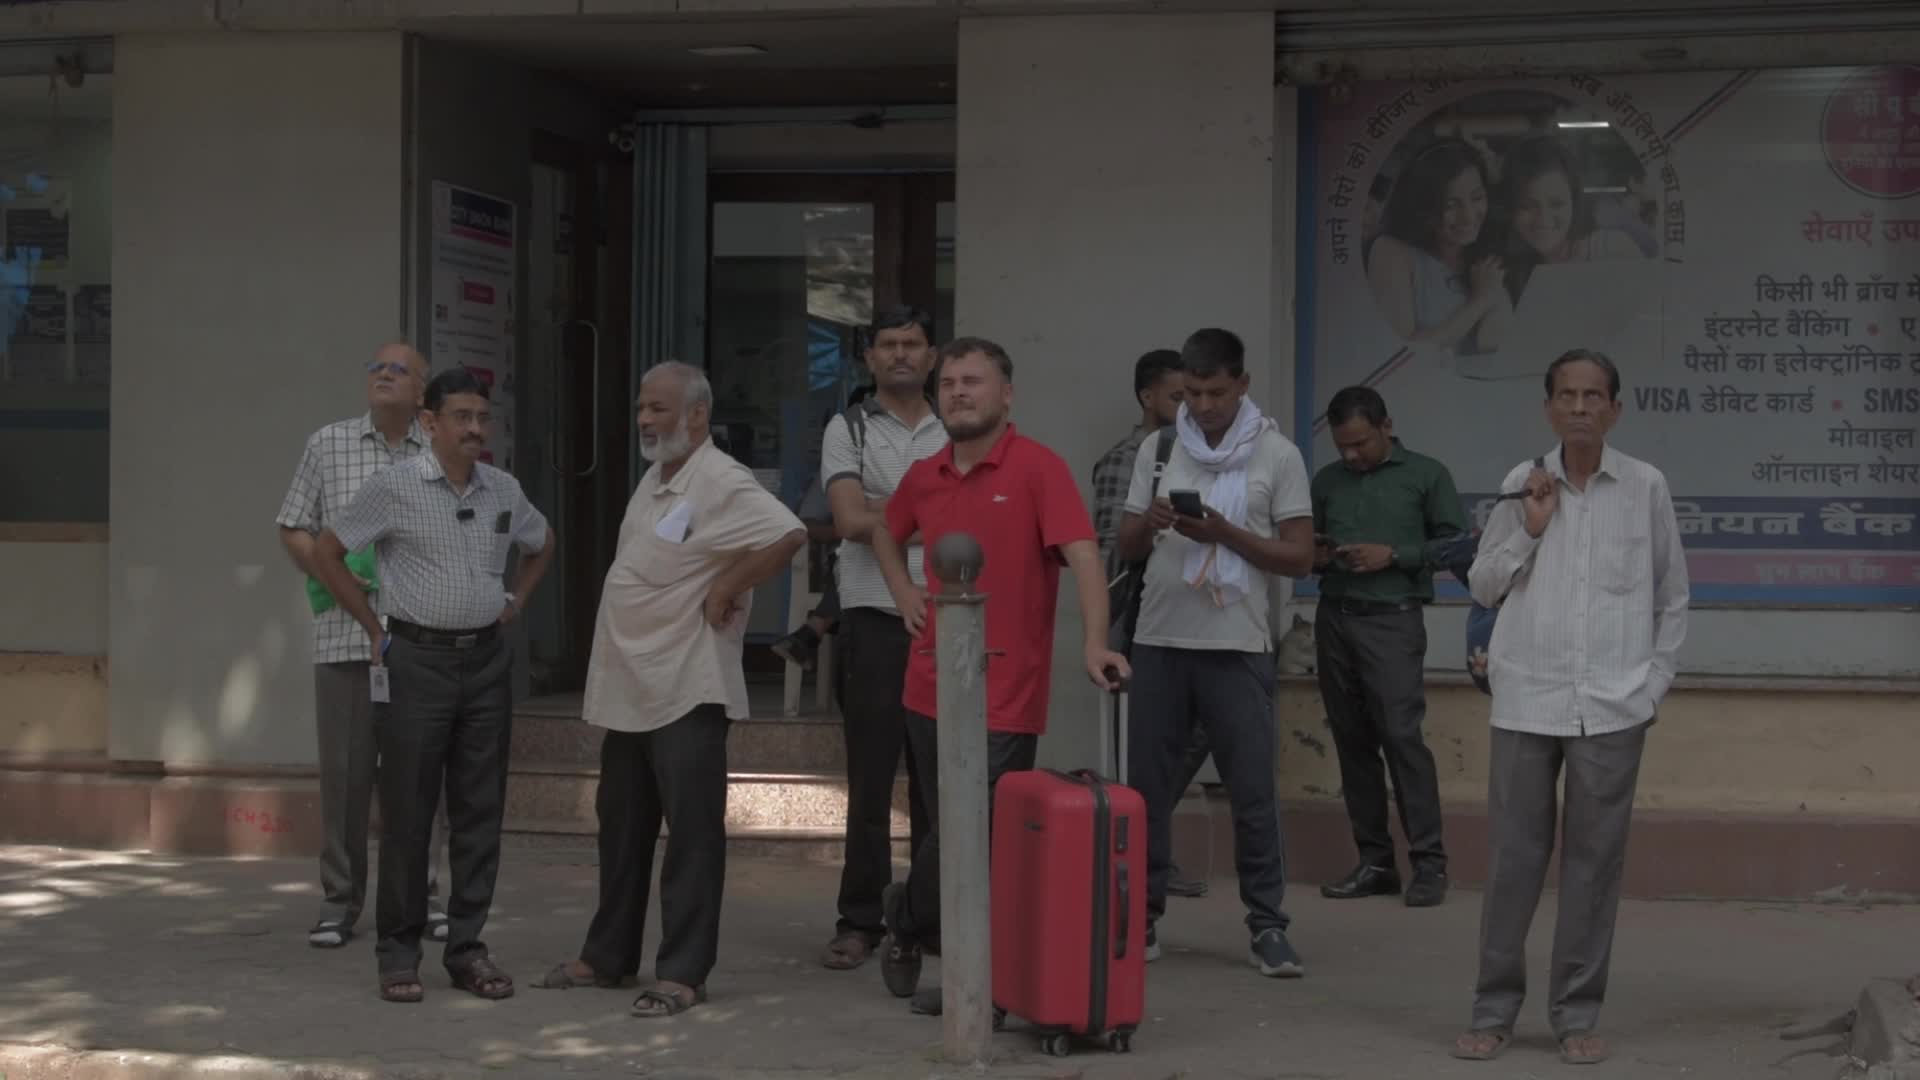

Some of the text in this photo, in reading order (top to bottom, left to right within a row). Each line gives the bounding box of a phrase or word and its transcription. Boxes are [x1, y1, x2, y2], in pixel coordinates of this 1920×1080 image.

[1327, 217, 1349, 265] अपने
[1346, 141, 1371, 170] को
[1754, 273, 1814, 302] किसी
[1820, 273, 1849, 302] भी
[1703, 309, 1780, 341] इंटरनेट
[1785, 309, 1852, 337] बैंकिंग
[1683, 344, 1731, 374] पैसों
[1736, 352, 1767, 373] का
[1634, 387, 1691, 413] VISA
[1765, 385, 1816, 414] कार्ड
[1863, 387, 1920, 414] SMS
[1751, 454, 1861, 487] ऑनलाइन
[1819, 502, 1916, 536] बैंक
